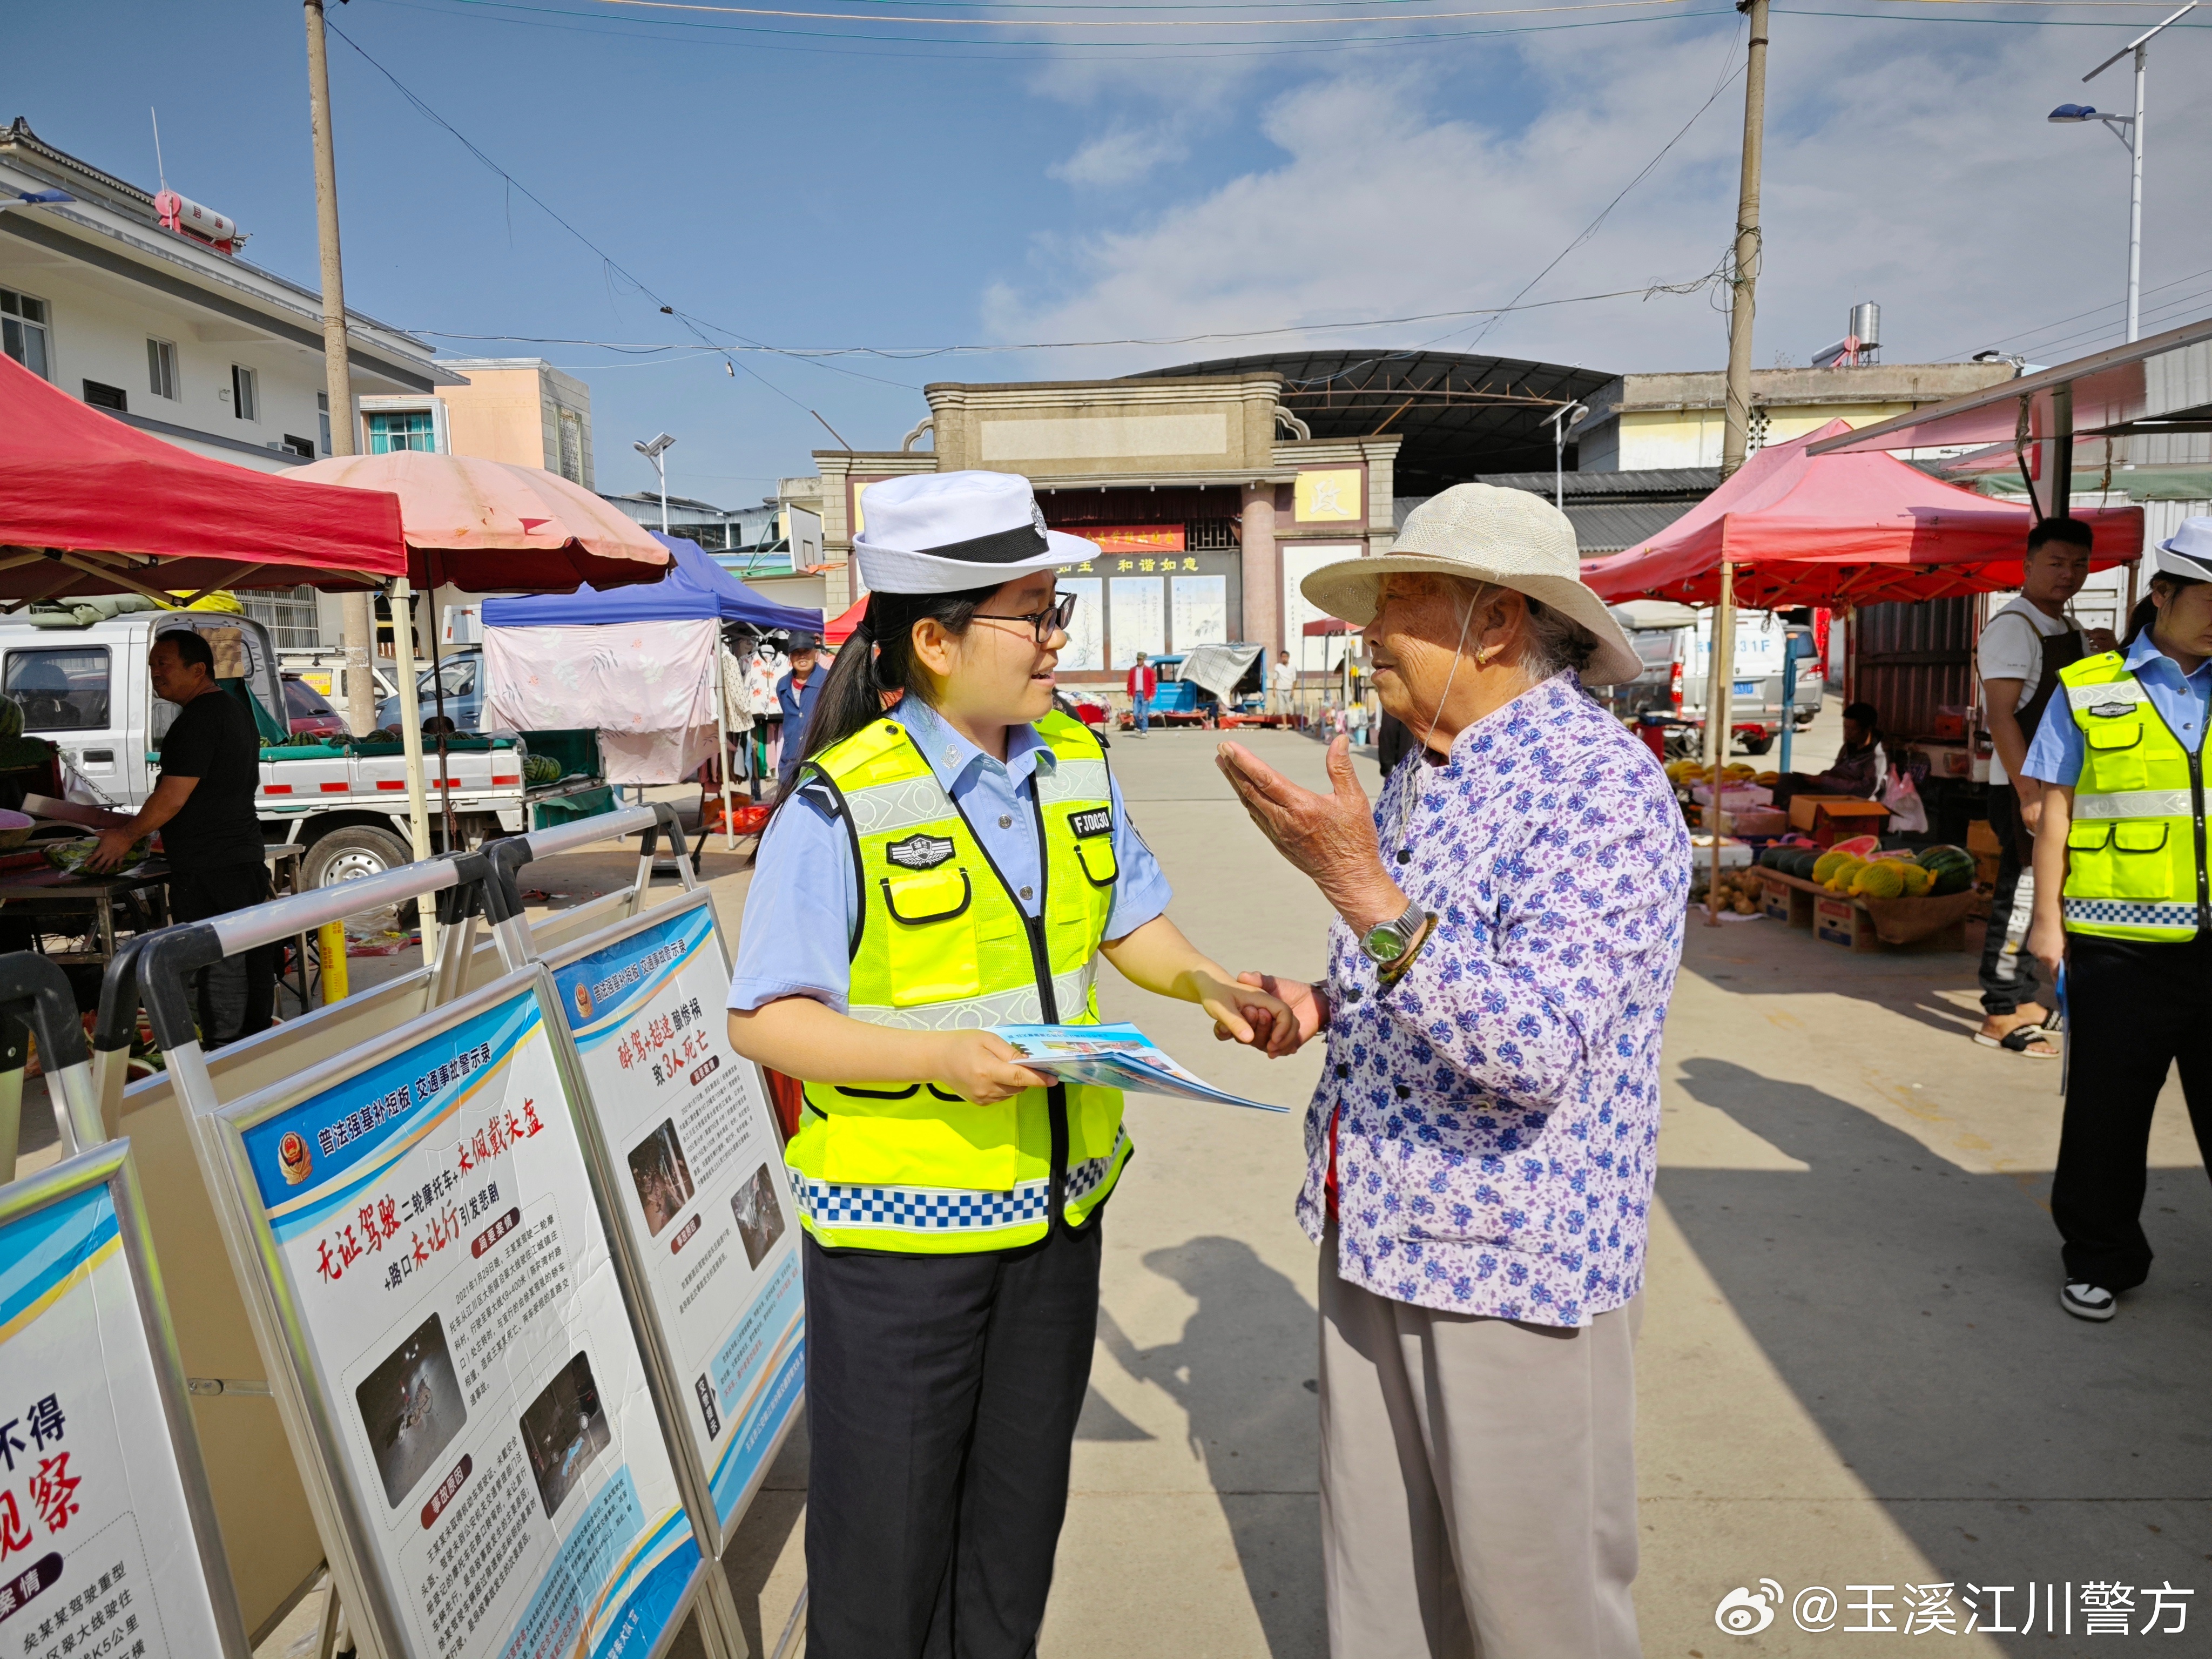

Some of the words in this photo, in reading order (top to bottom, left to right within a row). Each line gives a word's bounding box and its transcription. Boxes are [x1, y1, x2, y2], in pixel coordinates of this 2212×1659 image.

[1309, 478, 1350, 515] 政
[1118, 557, 1199, 572] 和谐如意
[1074, 812, 1109, 833] FJ0030
[316, 1083, 413, 1159] 普法强基补短板
[414, 1041, 492, 1101] 交通事故警示录
[477, 1212, 513, 1252] 简要案情
[469, 1377, 490, 1407] 通事故。
[430, 1465, 464, 1516] 事故原因
